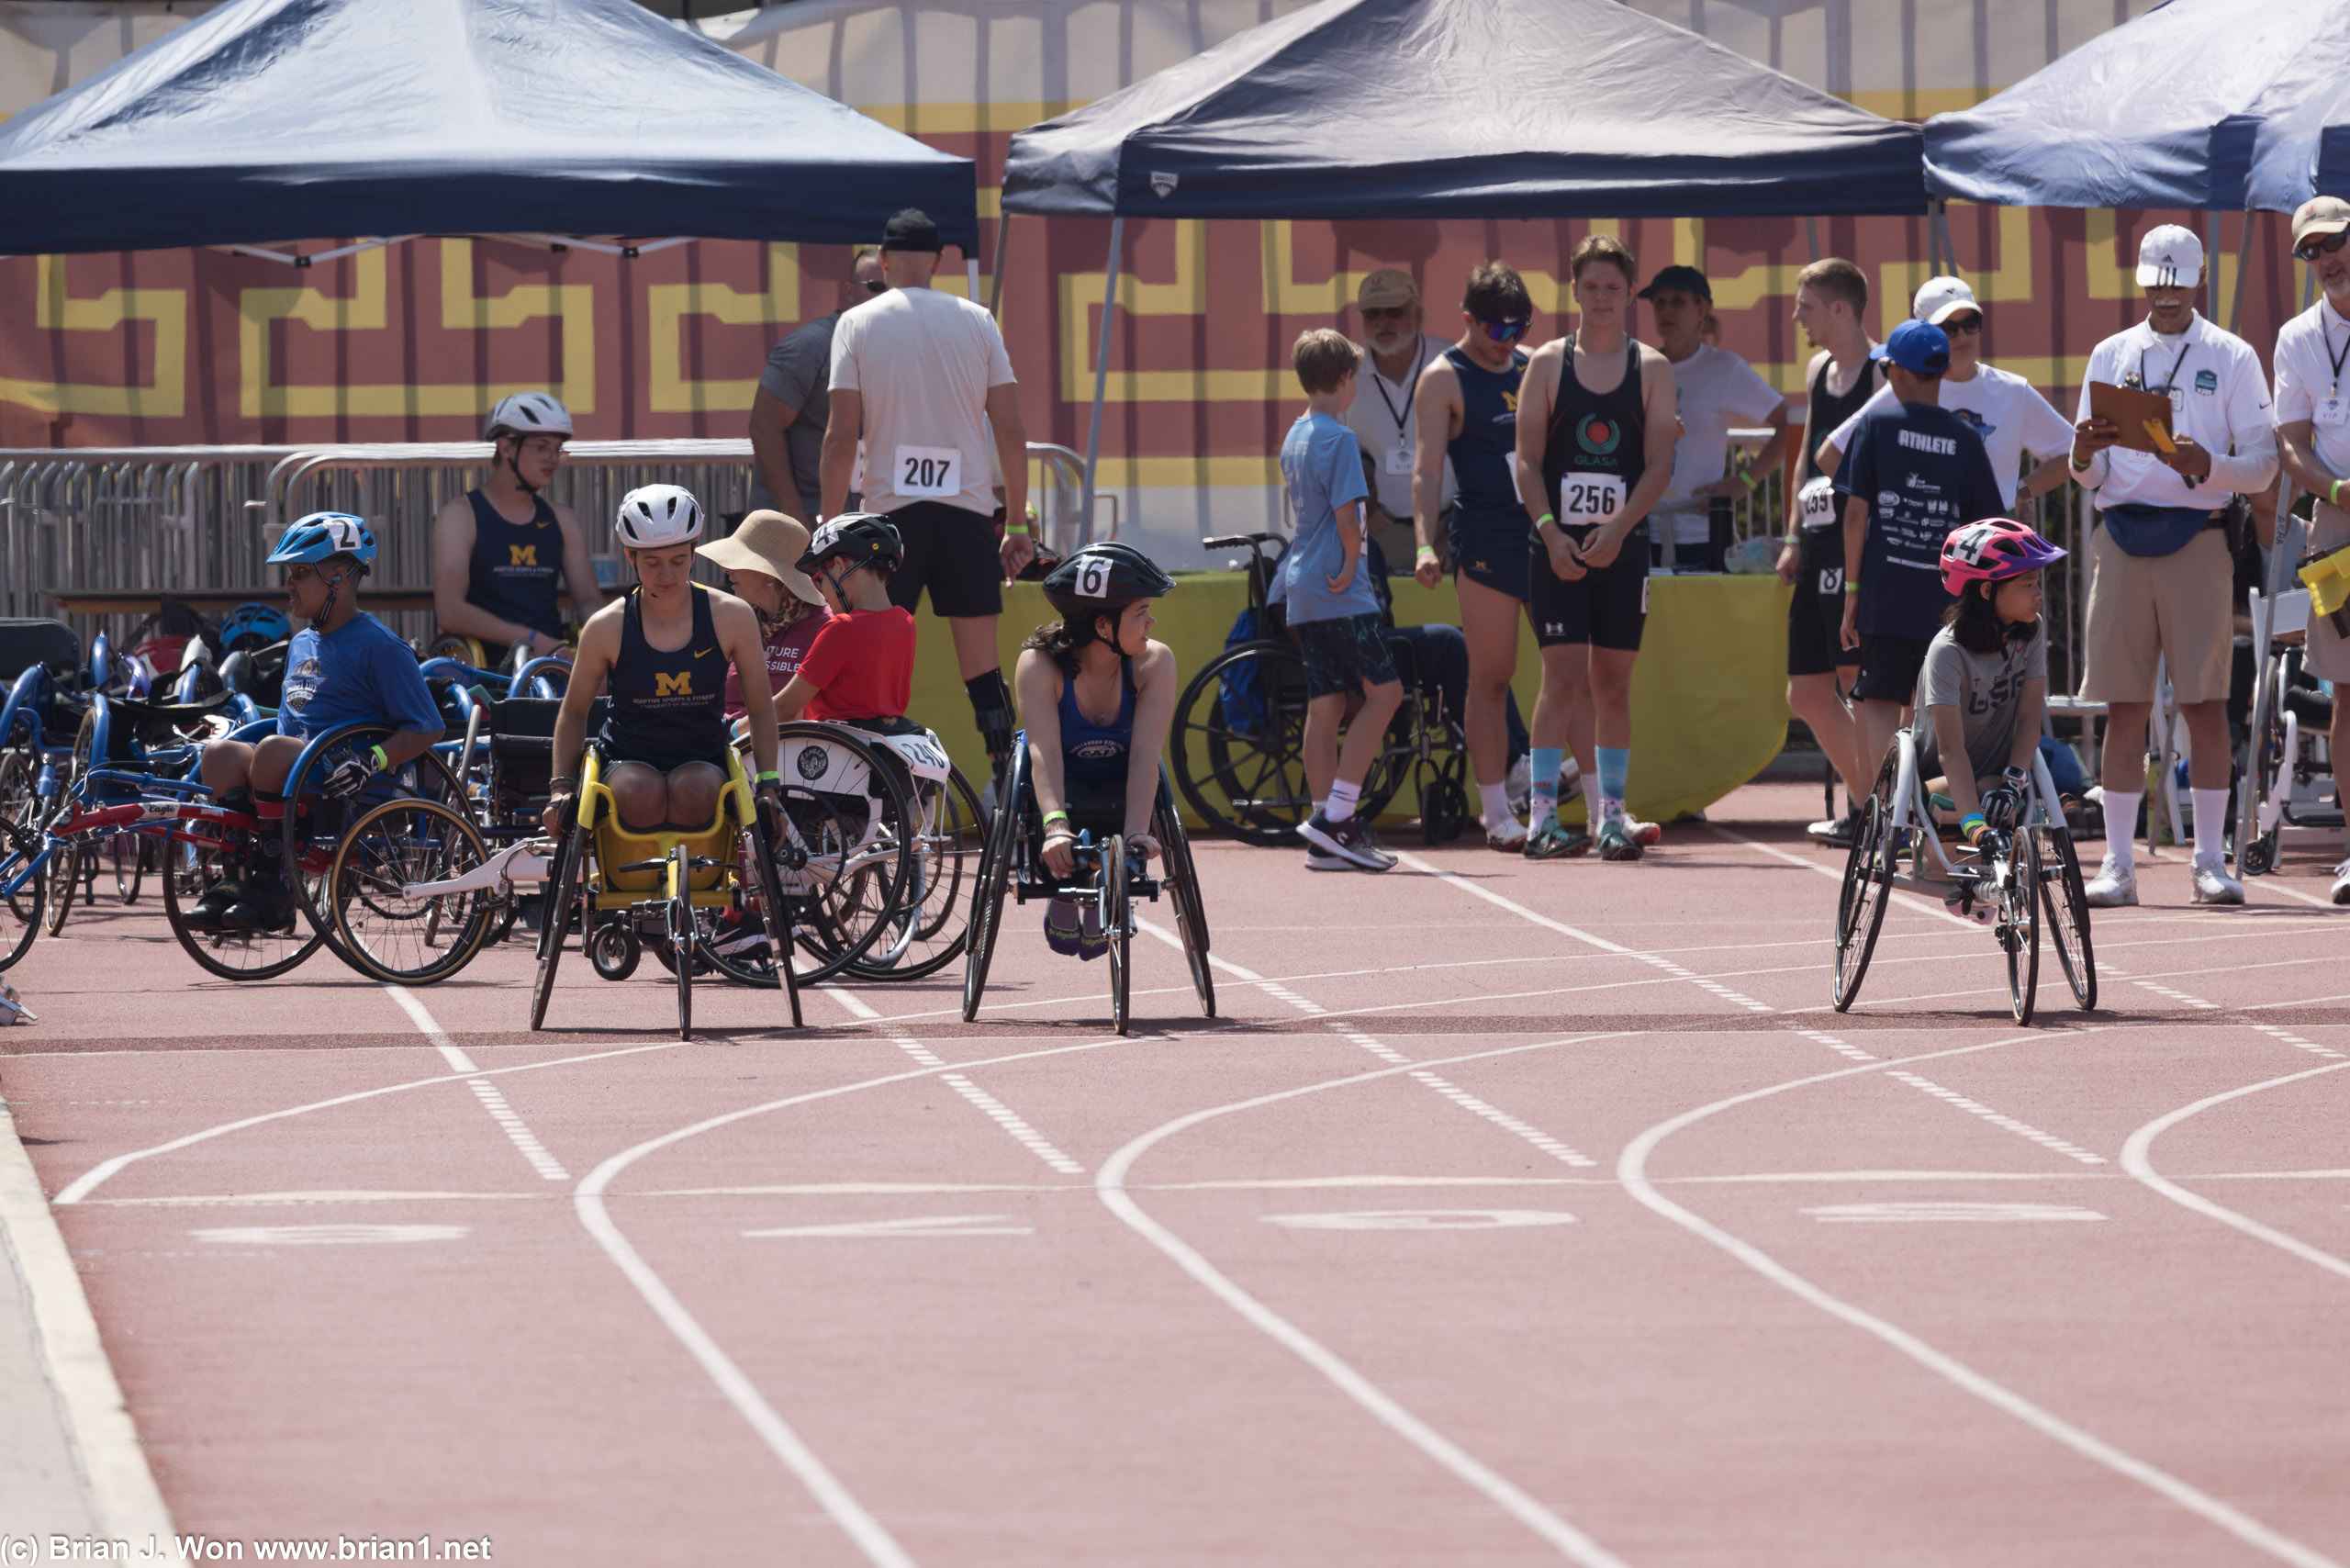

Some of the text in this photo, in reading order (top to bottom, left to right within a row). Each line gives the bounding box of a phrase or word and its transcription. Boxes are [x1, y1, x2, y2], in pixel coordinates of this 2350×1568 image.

[1898, 429, 1957, 455] ATHLETE
[904, 457, 951, 487] 207
[1574, 455, 1618, 466] GLASA
[1569, 484, 1617, 515] 256
[331, 519, 355, 548] 2
[815, 521, 831, 545] 4
[1959, 529, 1987, 561] 4
[509, 544, 537, 566] M
[1082, 559, 1107, 595] 6
[655, 671, 693, 697] M
[901, 743, 945, 768] 240
[149, 804, 175, 816] Eagle
